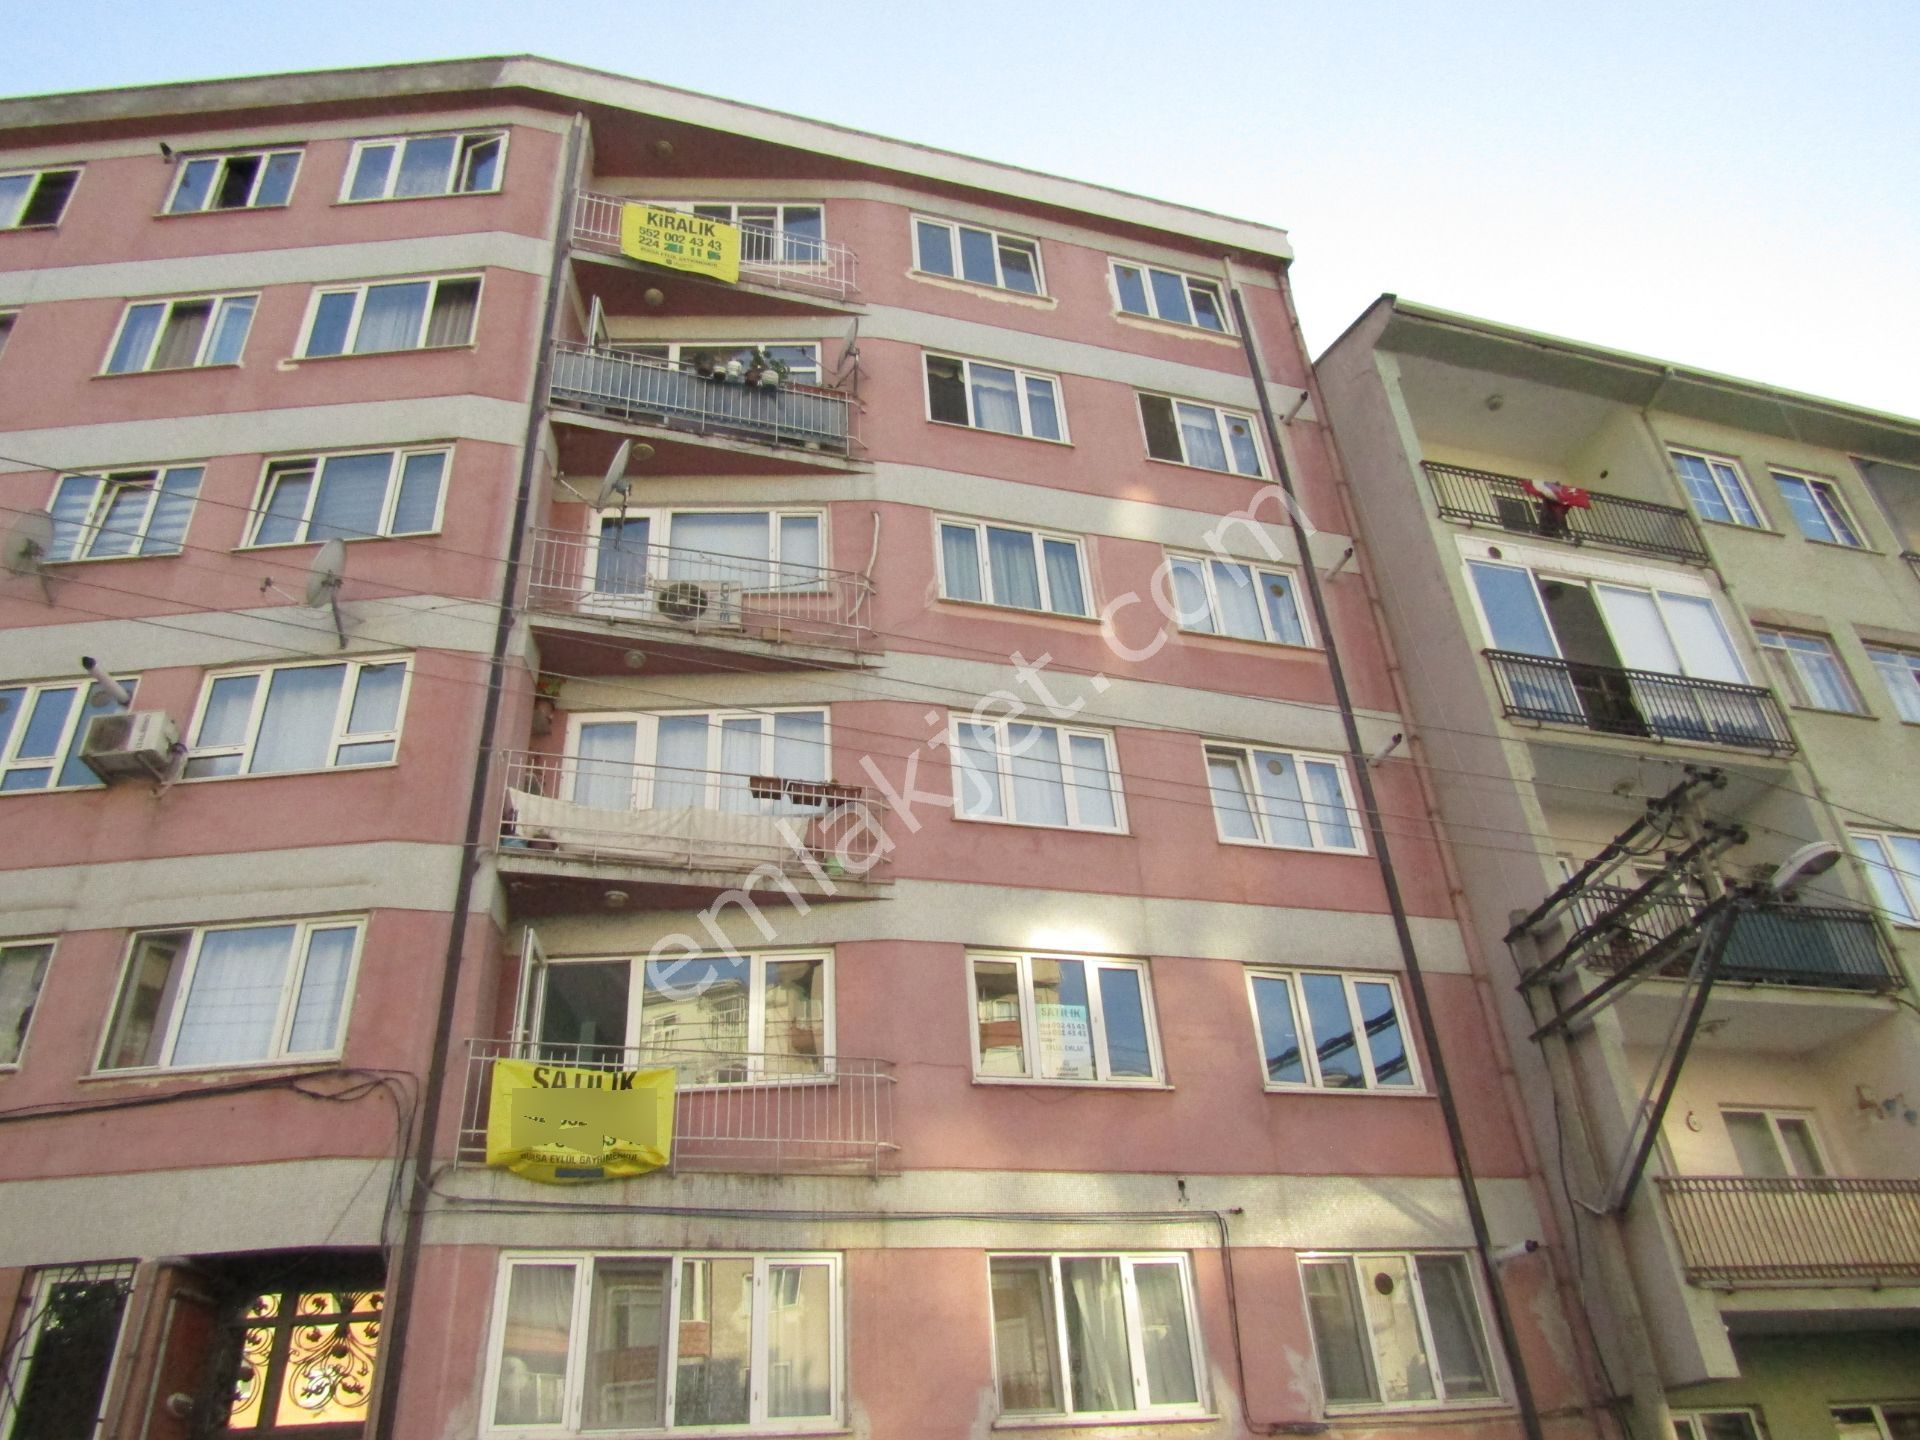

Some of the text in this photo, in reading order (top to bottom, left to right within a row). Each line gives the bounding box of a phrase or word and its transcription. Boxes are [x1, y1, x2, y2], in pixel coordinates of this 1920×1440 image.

[639, 226, 722, 251] 552 002 43 43
